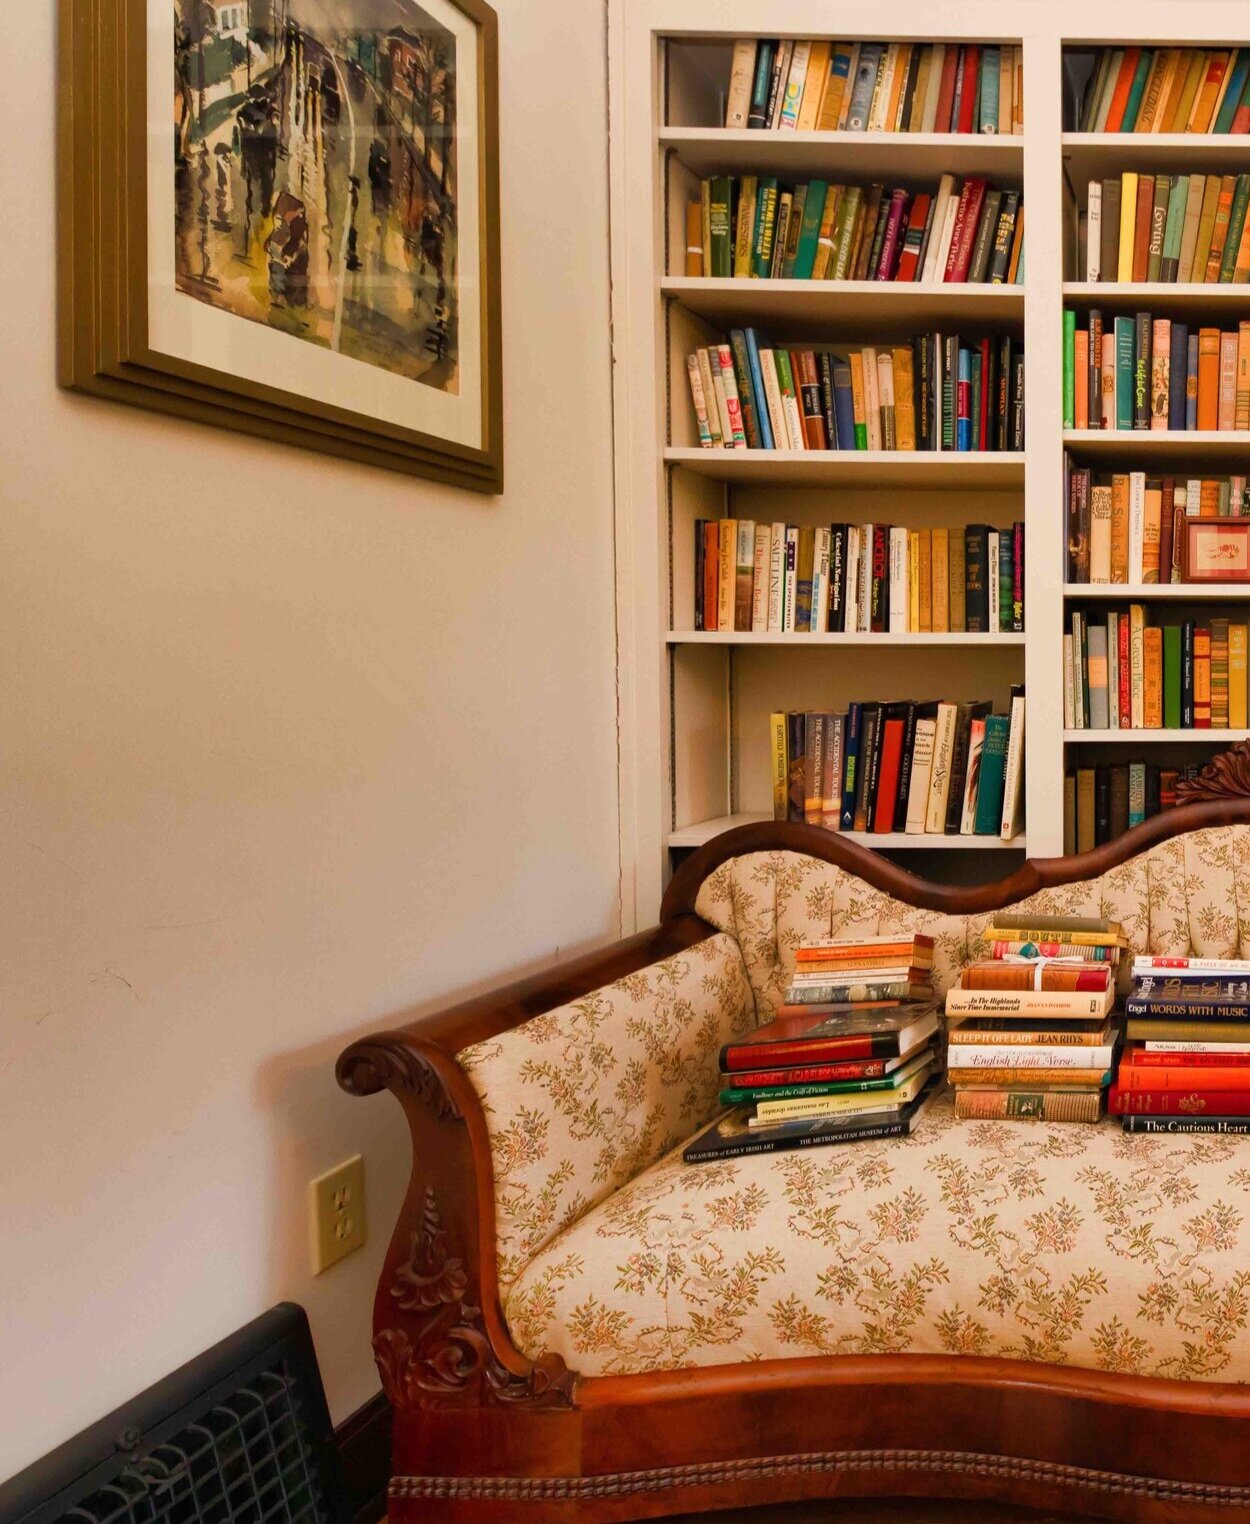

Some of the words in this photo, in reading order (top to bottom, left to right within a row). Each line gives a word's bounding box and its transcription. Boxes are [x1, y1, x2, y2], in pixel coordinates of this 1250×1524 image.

[875, 55, 887, 87] SEVEN
[957, 182, 973, 220] Katherine
[738, 204, 752, 257] ANCESTORS
[951, 219, 964, 242] Anne
[1149, 205, 1167, 256] Loving
[946, 244, 959, 272] Porter
[756, 549, 767, 563] The
[787, 541, 795, 571] FORD
[833, 531, 843, 566] Celestial
[754, 566, 765, 586] Days
[832, 567, 842, 611] Navigation
[754, 589, 763, 615] Before
[1014, 601, 1023, 620] Tyler
[1133, 625, 1142, 637] A
[1132, 639, 1142, 668] Green
[1132, 672, 1142, 699] Place
[814, 719, 823, 733] THE
[832, 720, 841, 733] THE
[813, 733, 823, 774] ACCIDENTAL
[831, 734, 841, 775] ACCIDENTAL
[813, 775, 822, 804] TOURIST
[831, 776, 840, 804] TOURIST
[1136, 768, 1144, 806] GABRIEL'S
[1018, 931, 1072, 943] SOUTH
[1152, 958, 1189, 968] FORD
[982, 1004, 1020, 1012] Immemorial
[1128, 1004, 1147, 1015] Engel
[1150, 1004, 1186, 1015] WORDS
[1188, 1005, 1214, 1016] WITH
[1217, 1006, 1249, 1017] MUSIC
[952, 1034, 980, 1043] SLEEP
[981, 1034, 991, 1043] IT
[991, 1034, 1010, 1043] OFF
[1010, 1034, 1033, 1043] LADY
[1035, 1034, 1058, 1044] JEAN
[1059, 1034, 1084, 1044] RHYS
[752, 1092, 774, 1100] Faulkner
[774, 1090, 784, 1098] and
[784, 1089, 792, 1097] the
[793, 1088, 807, 1098] Craft
[811, 1086, 829, 1095] Fiction
[762, 1106, 785, 1115] doradas
[787, 1103, 813, 1111] manzanas
[817, 1101, 829, 1109] Las
[800, 1136, 812, 1145] THE
[813, 1132, 858, 1144] METROPOLITAN
[858, 1129, 883, 1139] MUSEUM
[1144, 1120, 1166, 1132] The
[1167, 1121, 1215, 1133] Cautious
[1217, 1122, 1248, 1134] Heart
[686, 1151, 719, 1161] TREASURES
[725, 1147, 744, 1155] EARLY
[745, 1145, 762, 1153] IRISH
[762, 1143, 775, 1151] ART
